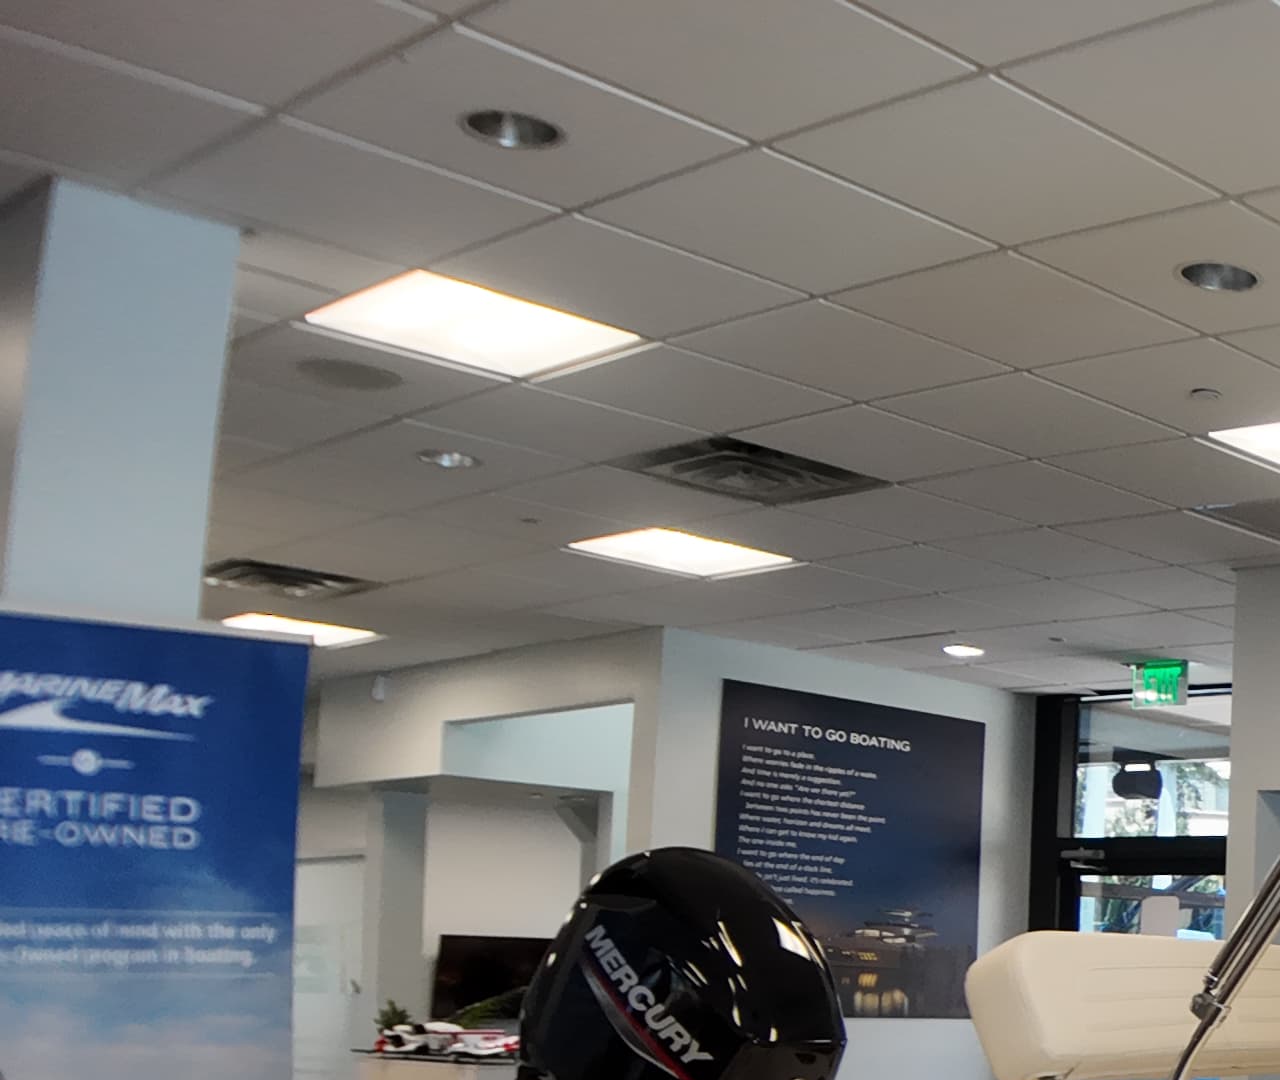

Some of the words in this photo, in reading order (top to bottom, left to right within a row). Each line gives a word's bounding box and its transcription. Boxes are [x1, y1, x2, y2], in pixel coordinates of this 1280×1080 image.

[743, 717, 749, 729] I
[752, 718, 799, 735] WANT
[802, 725, 823, 739] TO
[825, 729, 847, 743] GO
[849, 732, 911, 752] BOATING
[0, 787, 201, 824] ERTIFIED
[0, 818, 201, 850] E-OWNED
[584, 924, 714, 1064] MERCURY
